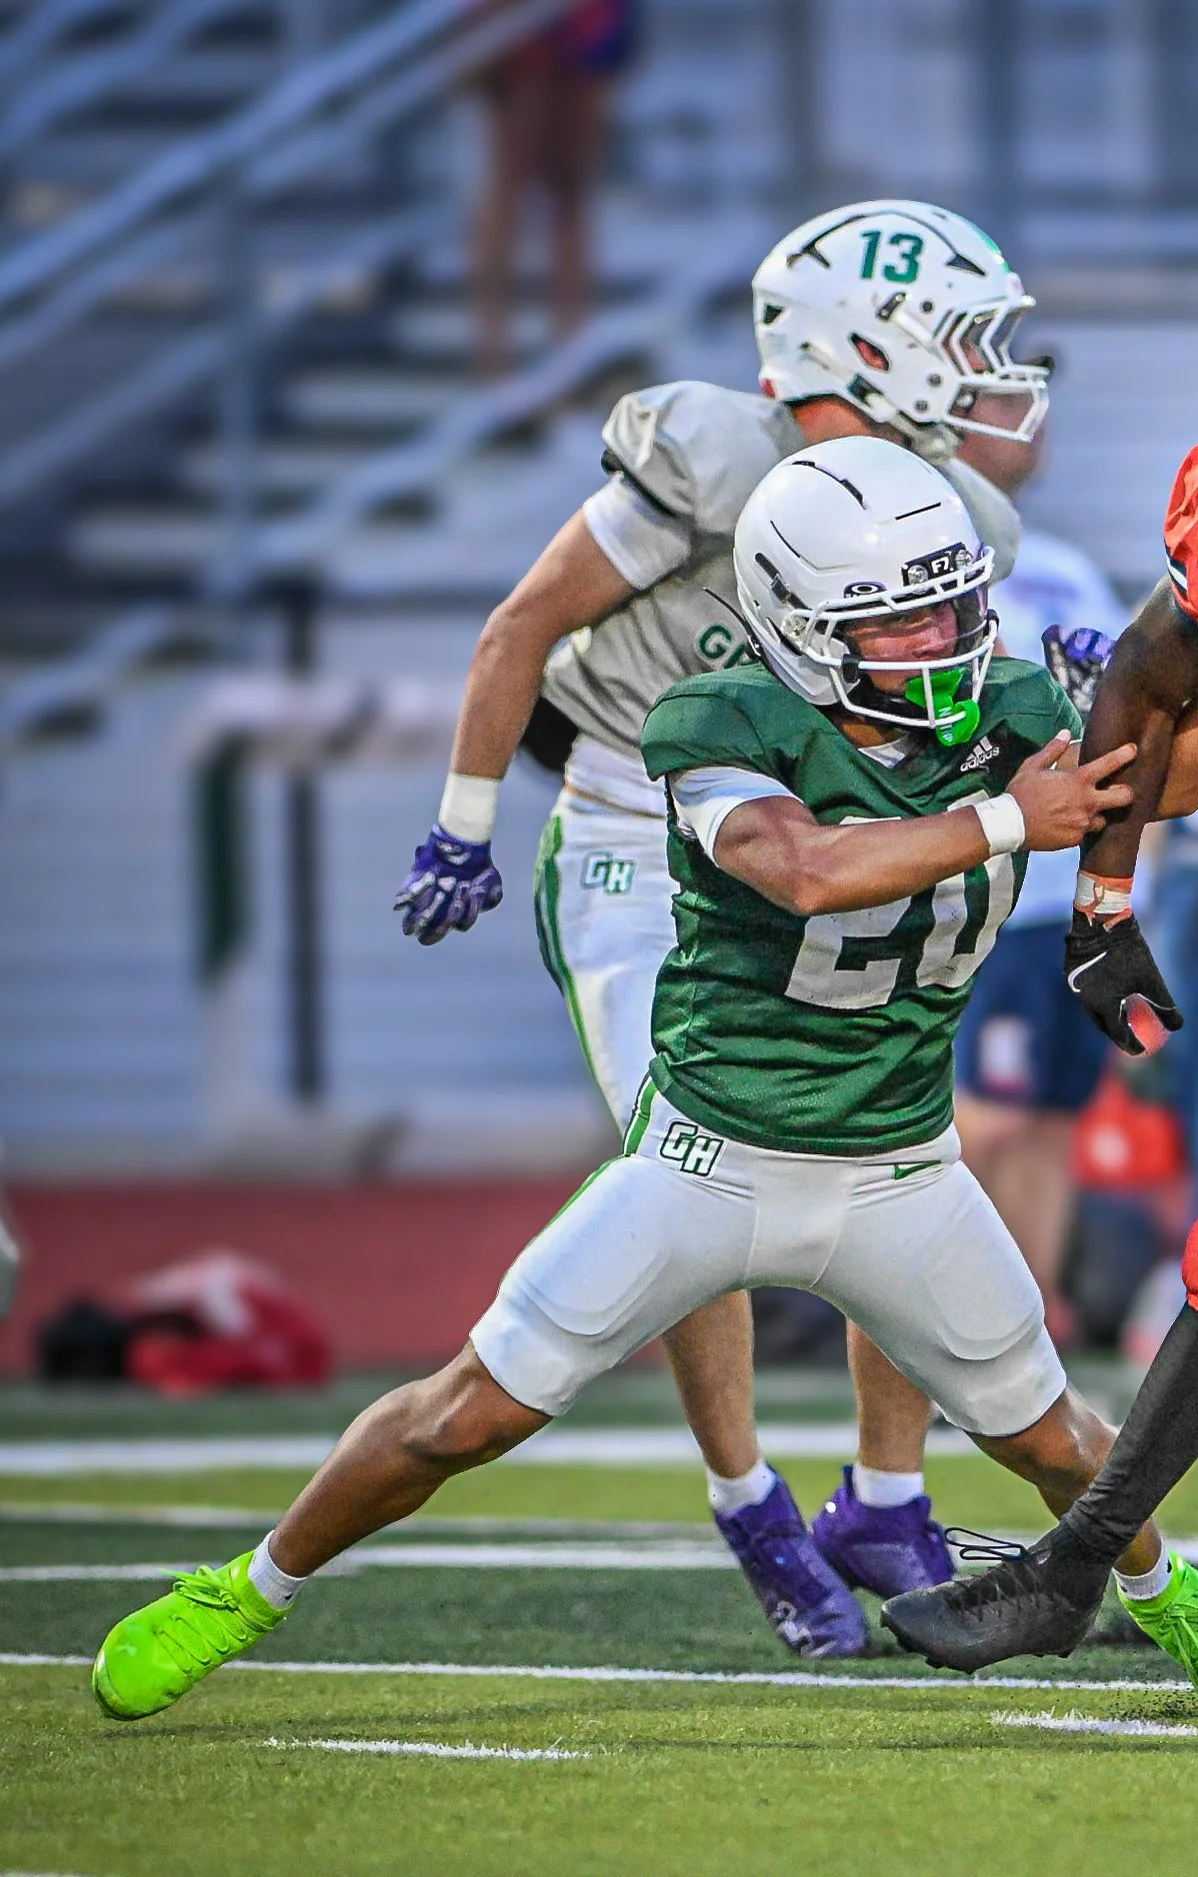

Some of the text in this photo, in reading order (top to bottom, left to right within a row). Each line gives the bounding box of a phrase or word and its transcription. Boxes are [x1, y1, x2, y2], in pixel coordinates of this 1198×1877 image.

[859, 230, 925, 285] 13
[960, 746, 1000, 773] adidas
[580, 851, 637, 895] GH
[784, 789, 1016, 1010] 20
[659, 1120, 725, 1177] GH
